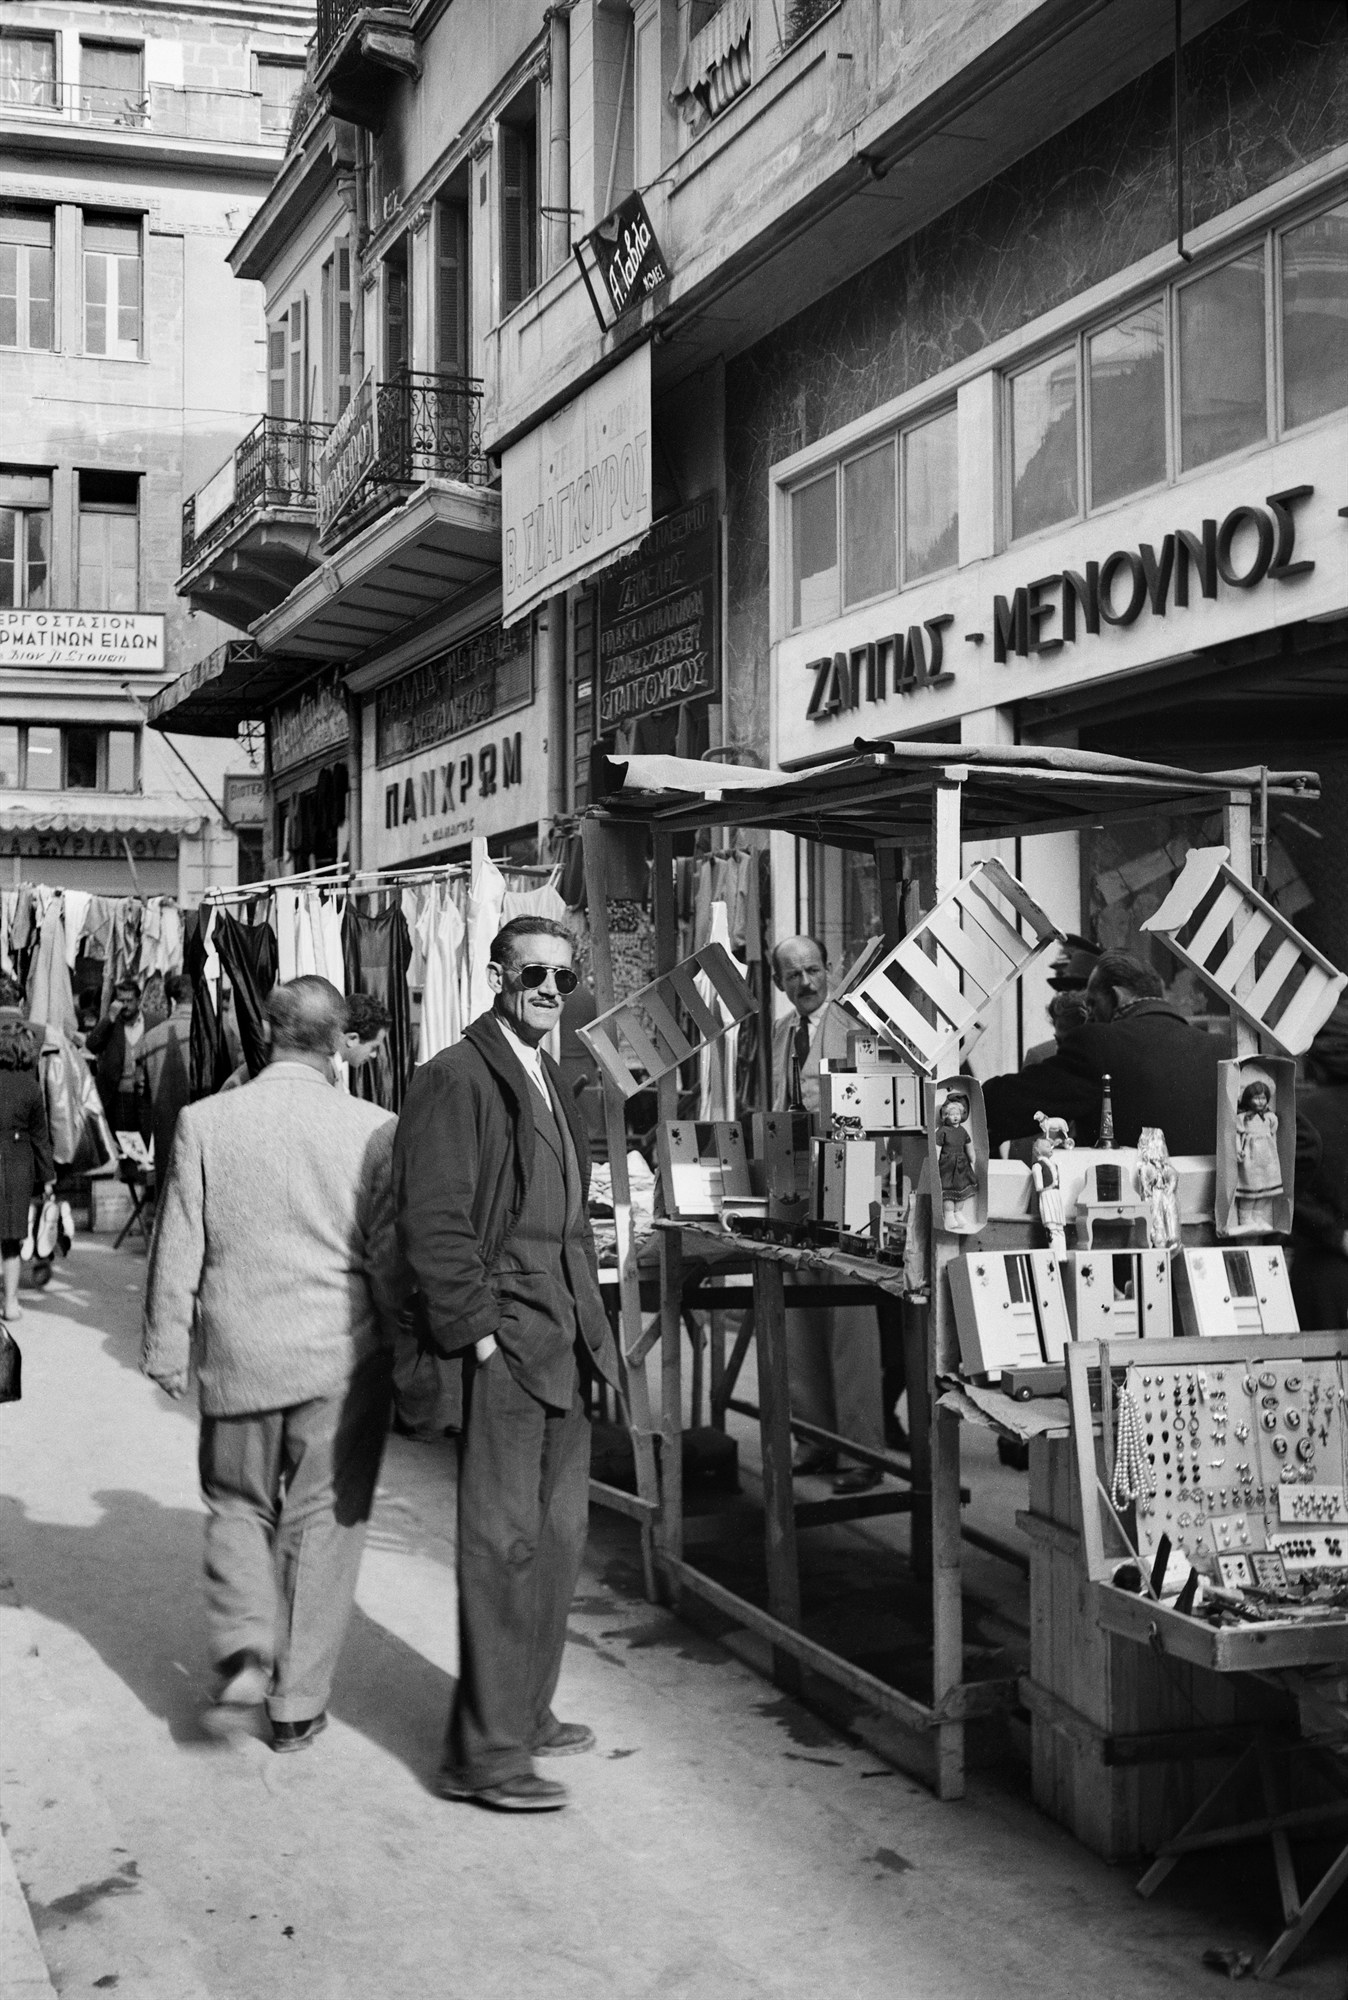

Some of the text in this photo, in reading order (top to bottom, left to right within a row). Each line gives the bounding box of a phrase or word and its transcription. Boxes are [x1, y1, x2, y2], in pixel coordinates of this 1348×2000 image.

[101, 632, 159, 650] ΕΙΔΩΝ
[805, 613, 955, 722] ΖΑΠΠΑΣ
[385, 731, 522, 830] ΠΑΝΧΡΩΜ
